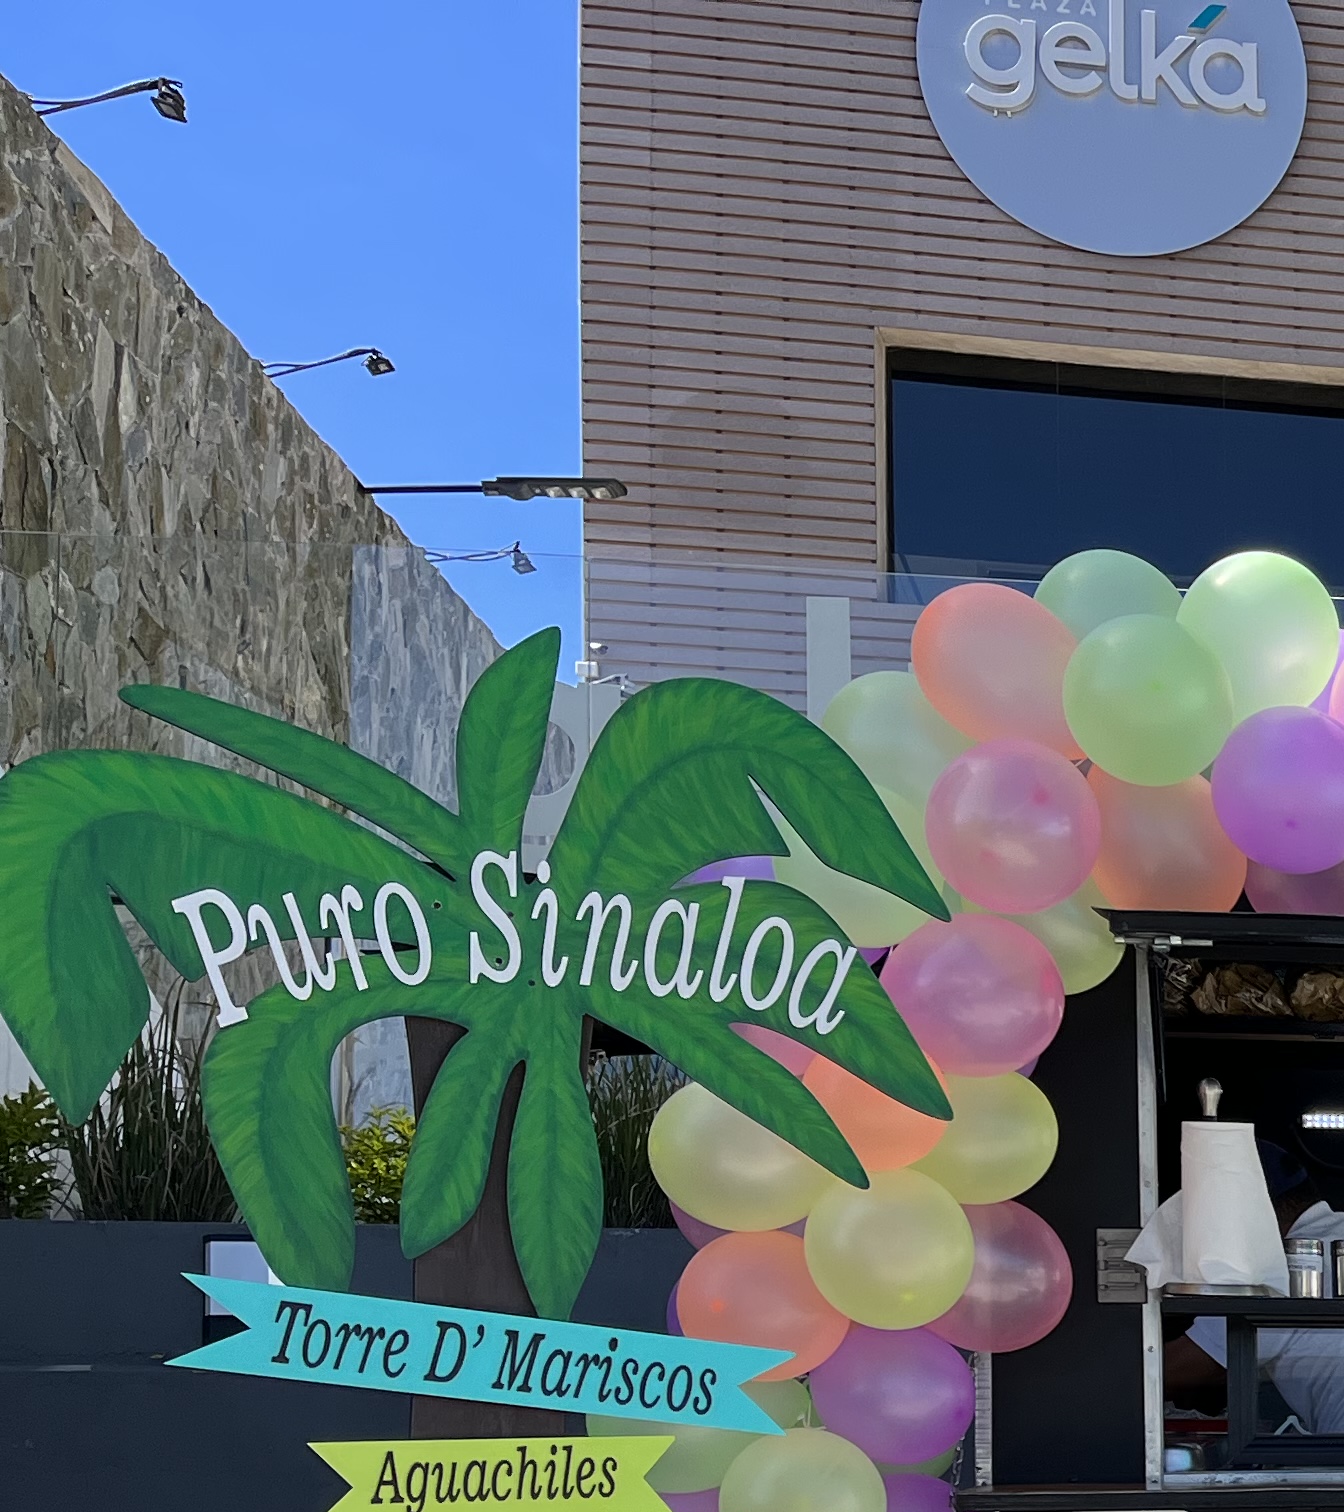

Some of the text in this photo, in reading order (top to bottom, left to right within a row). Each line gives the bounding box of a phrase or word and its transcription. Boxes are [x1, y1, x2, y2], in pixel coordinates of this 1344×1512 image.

[984, 0, 1097, 17] LAZA
[172, 850, 860, 1035] Puro Sinaloa
[271, 1301, 411, 1381] Torre
[492, 1330, 718, 1415] Mariscos
